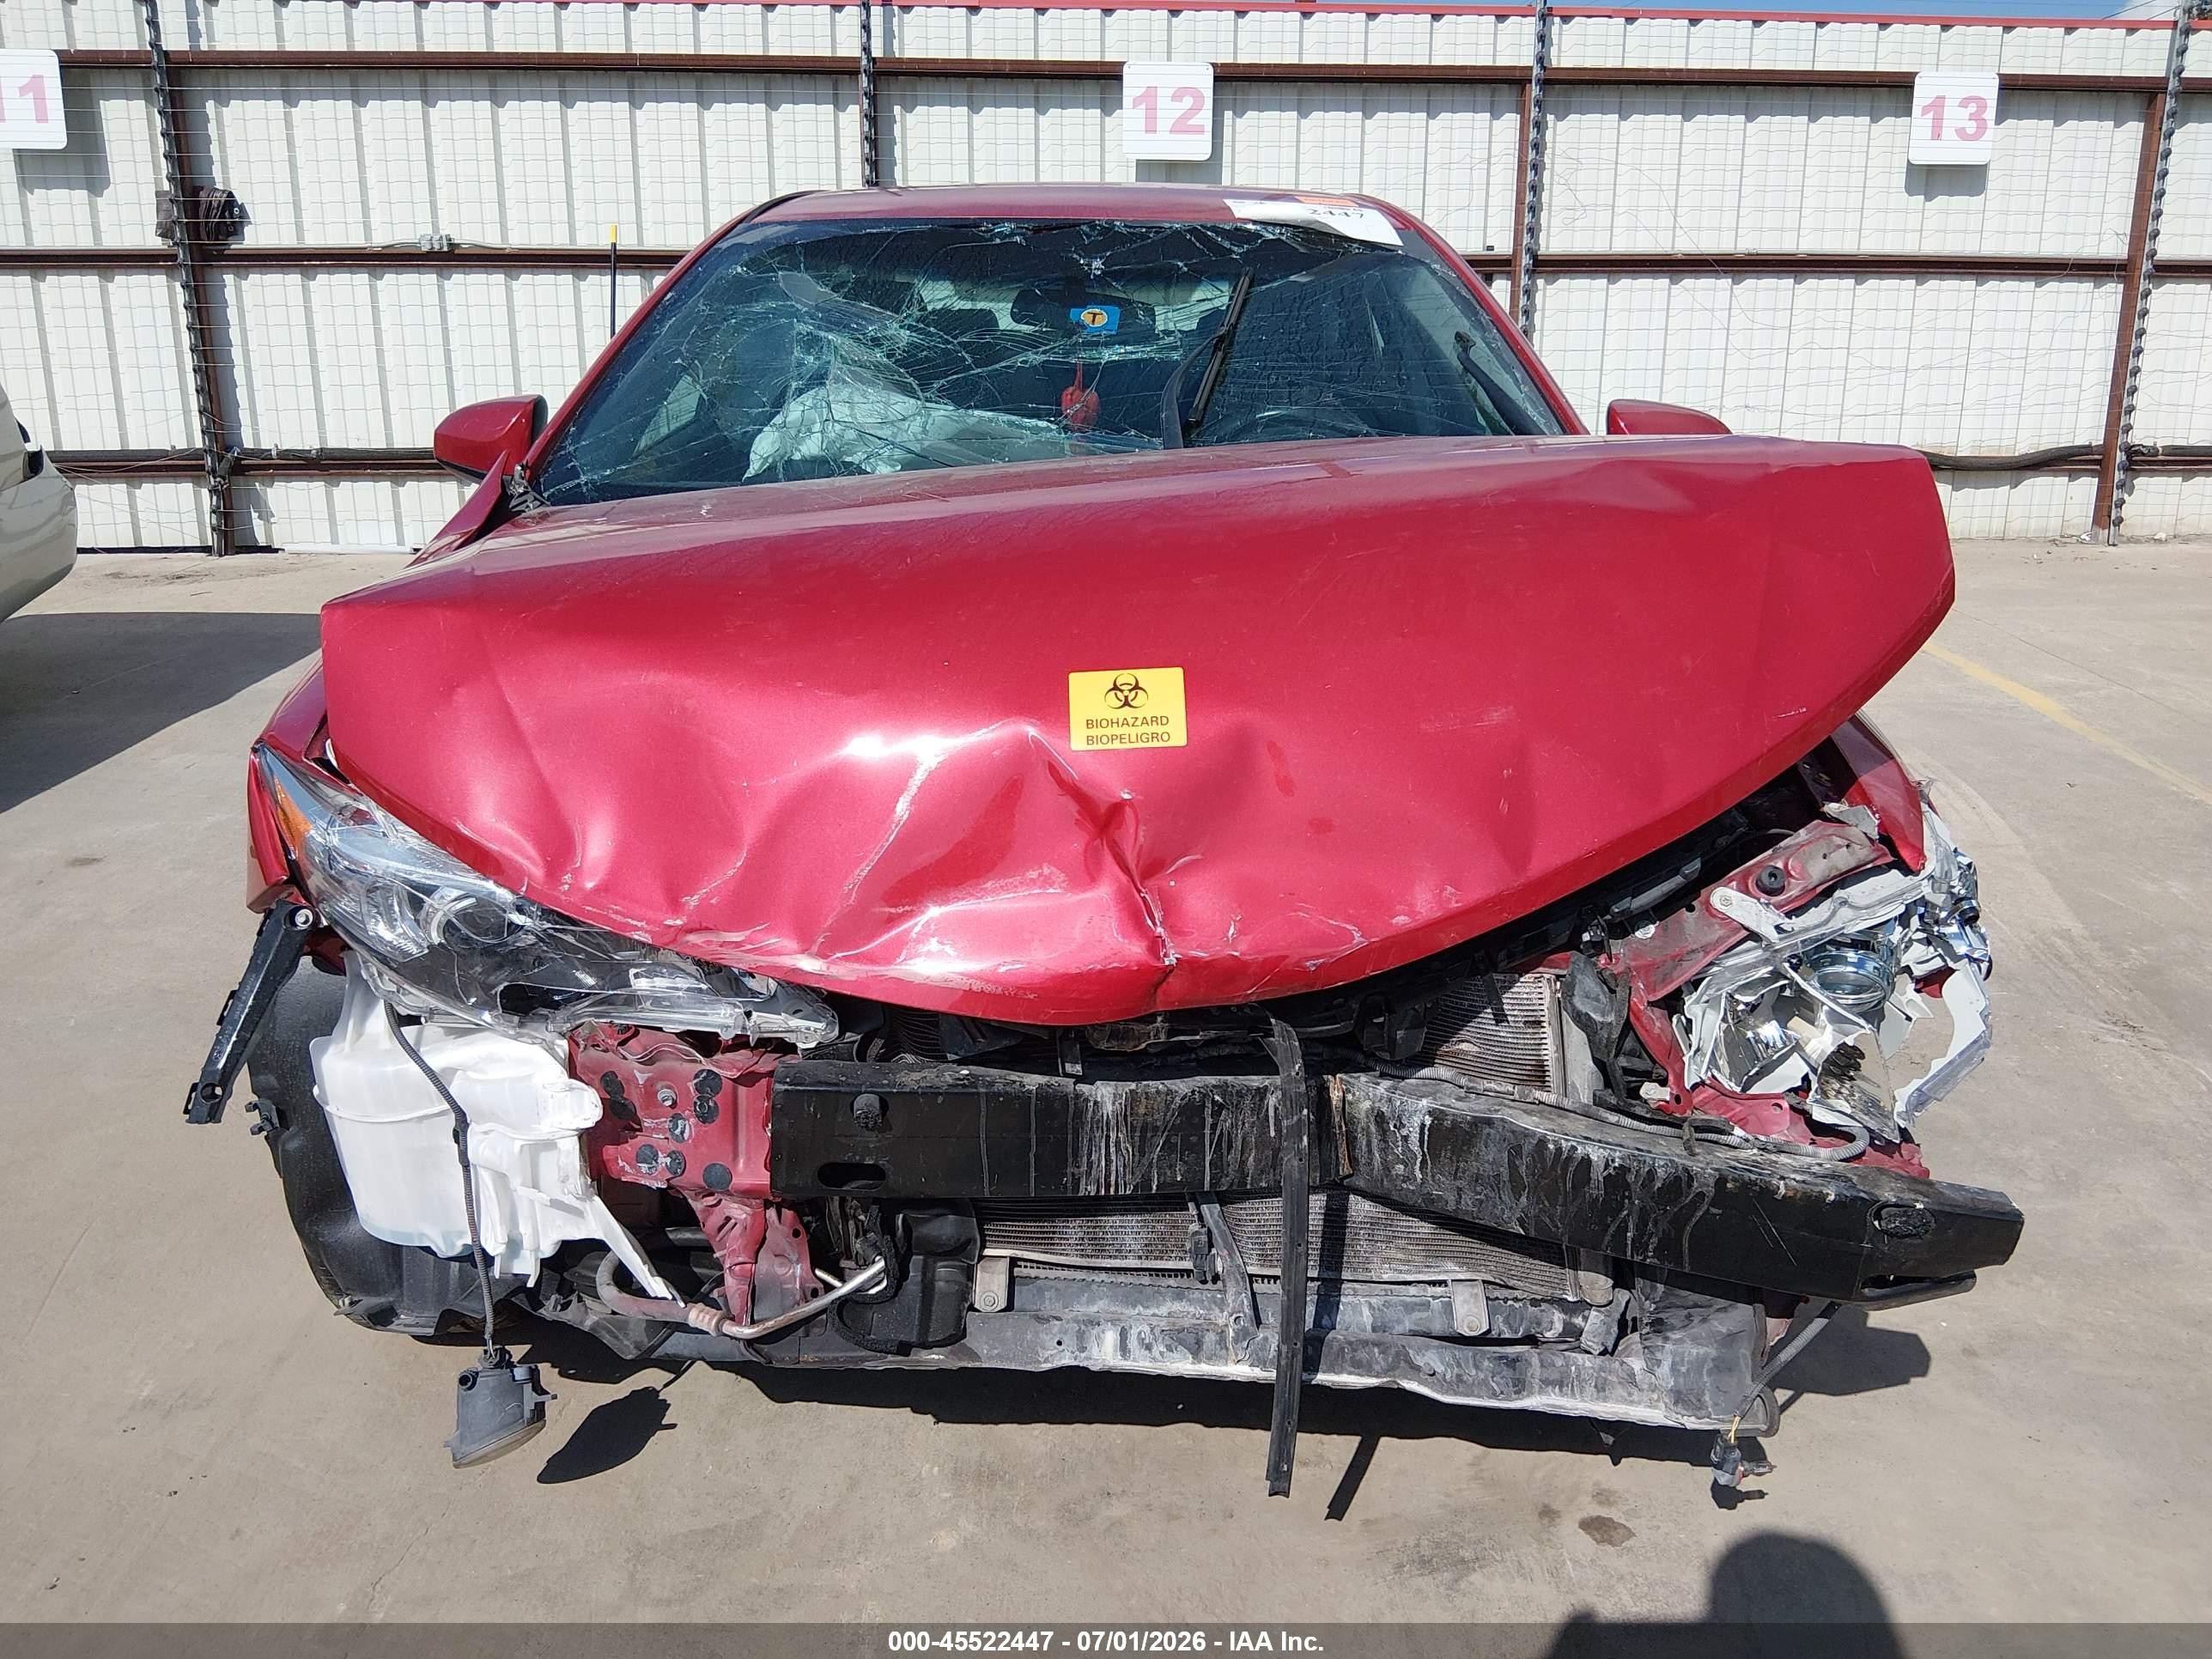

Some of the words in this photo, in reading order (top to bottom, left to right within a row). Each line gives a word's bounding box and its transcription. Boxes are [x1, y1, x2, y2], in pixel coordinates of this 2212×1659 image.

[0, 74, 49, 124] 1
[1132, 86, 1206, 135] 12
[1920, 94, 1988, 142] 13
[1085, 715, 1170, 729] BIOHAZARD
[1086, 732, 1170, 745] BIOPELIGRO
